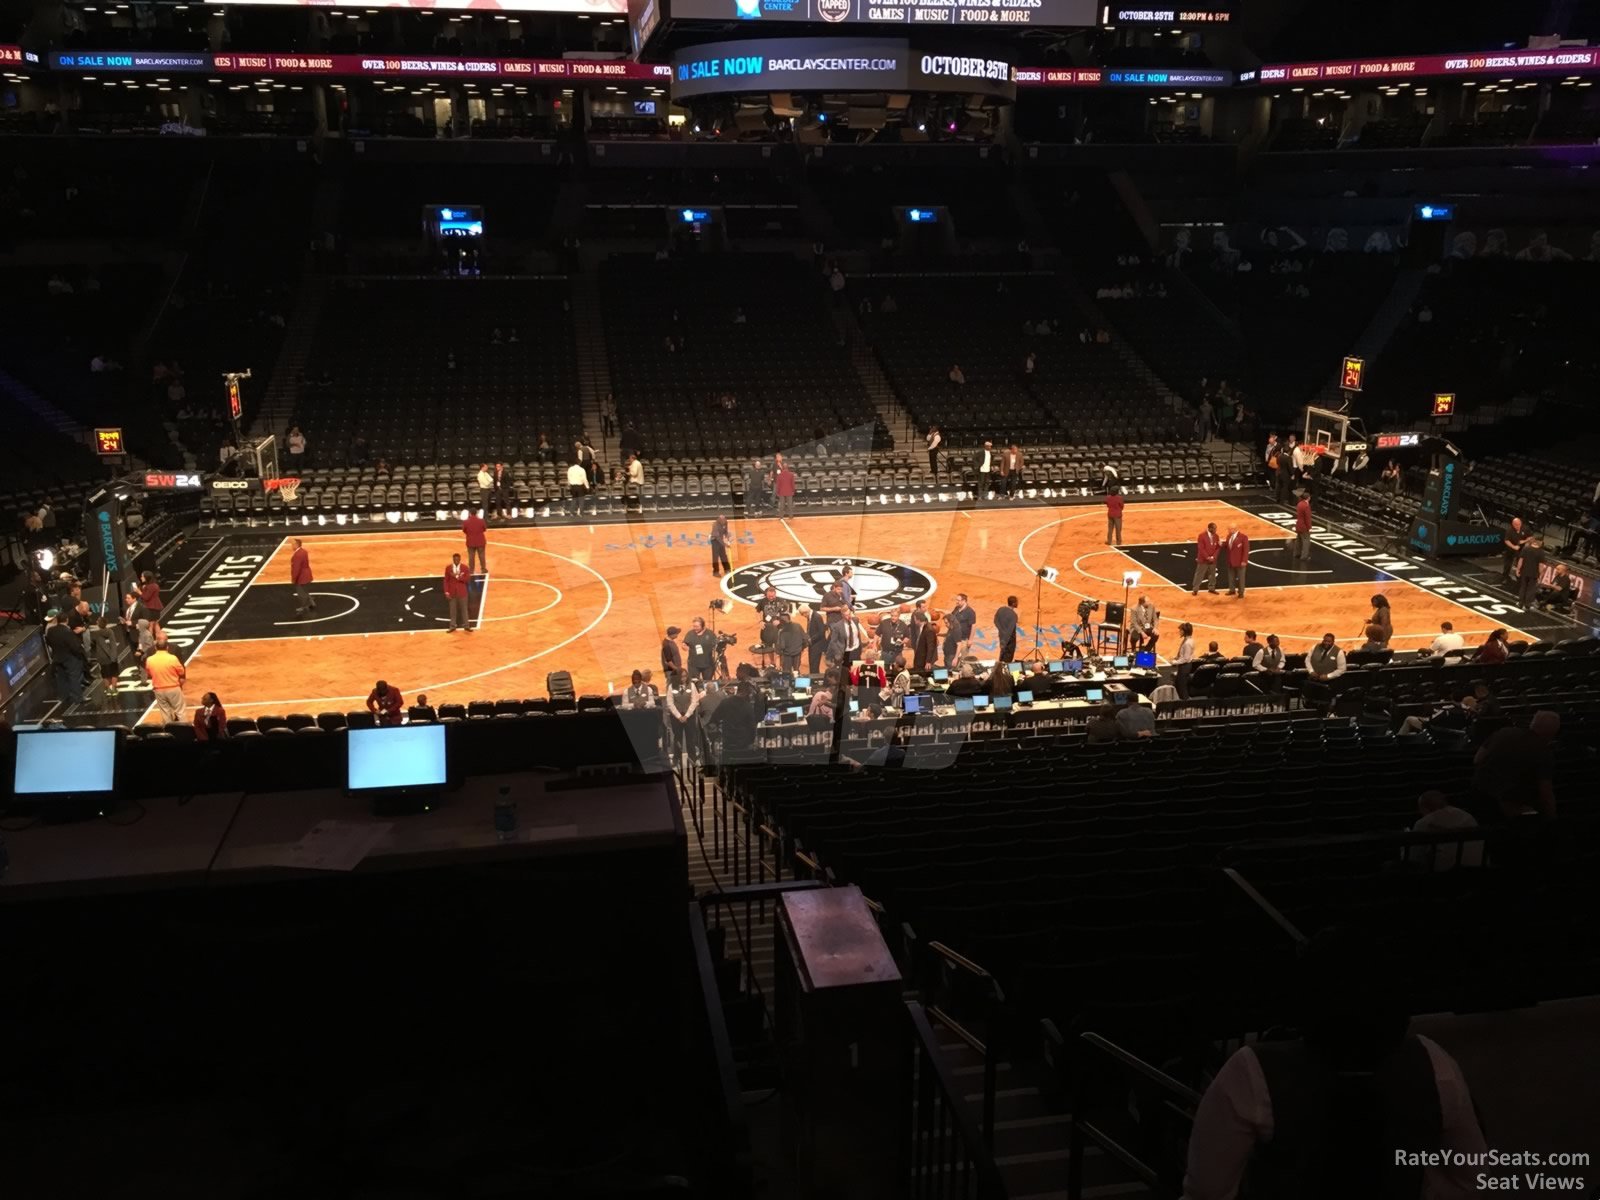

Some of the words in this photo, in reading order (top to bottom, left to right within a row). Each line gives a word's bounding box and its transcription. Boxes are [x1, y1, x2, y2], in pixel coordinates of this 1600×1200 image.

[868, 8, 904, 20] GAMES
[914, 8, 949, 20] MUSIC
[960, 9, 989, 21] FOOD
[990, 10, 998, 21] &
[1000, 10, 1030, 22] MORE
[1119, 11, 1153, 20] OCTOBER
[1154, 11, 1174, 20] 25TH
[60, 56, 75, 65] ON
[77, 57, 104, 65] SALE
[107, 57, 132, 66] NOW
[239, 58, 266, 67] MUSIC
[275, 59, 299, 67] FOOD
[299, 59, 307, 68] &
[308, 59, 333, 68] MORE
[362, 60, 385, 69] OVER
[385, 61, 400, 69] 100
[457, 62, 465, 71] &
[465, 63, 497, 71] CIDERS
[1445, 59, 1468, 69] OVER
[1469, 59, 1485, 68] 100
[1546, 55, 1555, 65] &
[1555, 54, 1591, 64] CIDERS
[504, 63, 532, 72] GAMES
[539, 64, 565, 73] MUSIC
[573, 64, 595, 73] FOOD
[595, 65, 602, 74] &
[603, 65, 626, 74] MORE
[678, 64, 689, 81] ON
[691, 59, 720, 79] SALE
[724, 56, 763, 75] NOW
[768, 58, 897, 71] BARCLAYSCENTER.COM
[921, 55, 986, 77] OCTOBER
[986, 60, 1009, 81] 25TH
[1292, 67, 1319, 77] GAMES
[1325, 65, 1352, 75] MUSIC
[1359, 63, 1382, 74] FOOD
[1382, 63, 1390, 72] &
[1391, 62, 1416, 72] MORE
[1047, 72, 1072, 80] GAMES
[1078, 72, 1101, 80] MUSIC
[1110, 73, 1122, 81] ON
[1124, 74, 1145, 82] SALE
[1147, 74, 1168, 82] NOW
[1345, 370, 1358, 386] 24
[103, 440, 117, 450] 24
[1377, 434, 1419, 448] SW24
[146, 474, 201, 487] SW24
[212, 481, 248, 489] GEICO
[1440, 473, 1453, 516] BARCLAYS
[1457, 534, 1501, 545] BARCLAYS
[101, 523, 118, 572] BARCLAYS
[740, 559, 812, 577] YORK
[831, 558, 897, 571] NEW
[200, 555, 264, 589] NETS
[1408, 576, 1525, 615] NETS
[865, 676, 870, 689] 1
